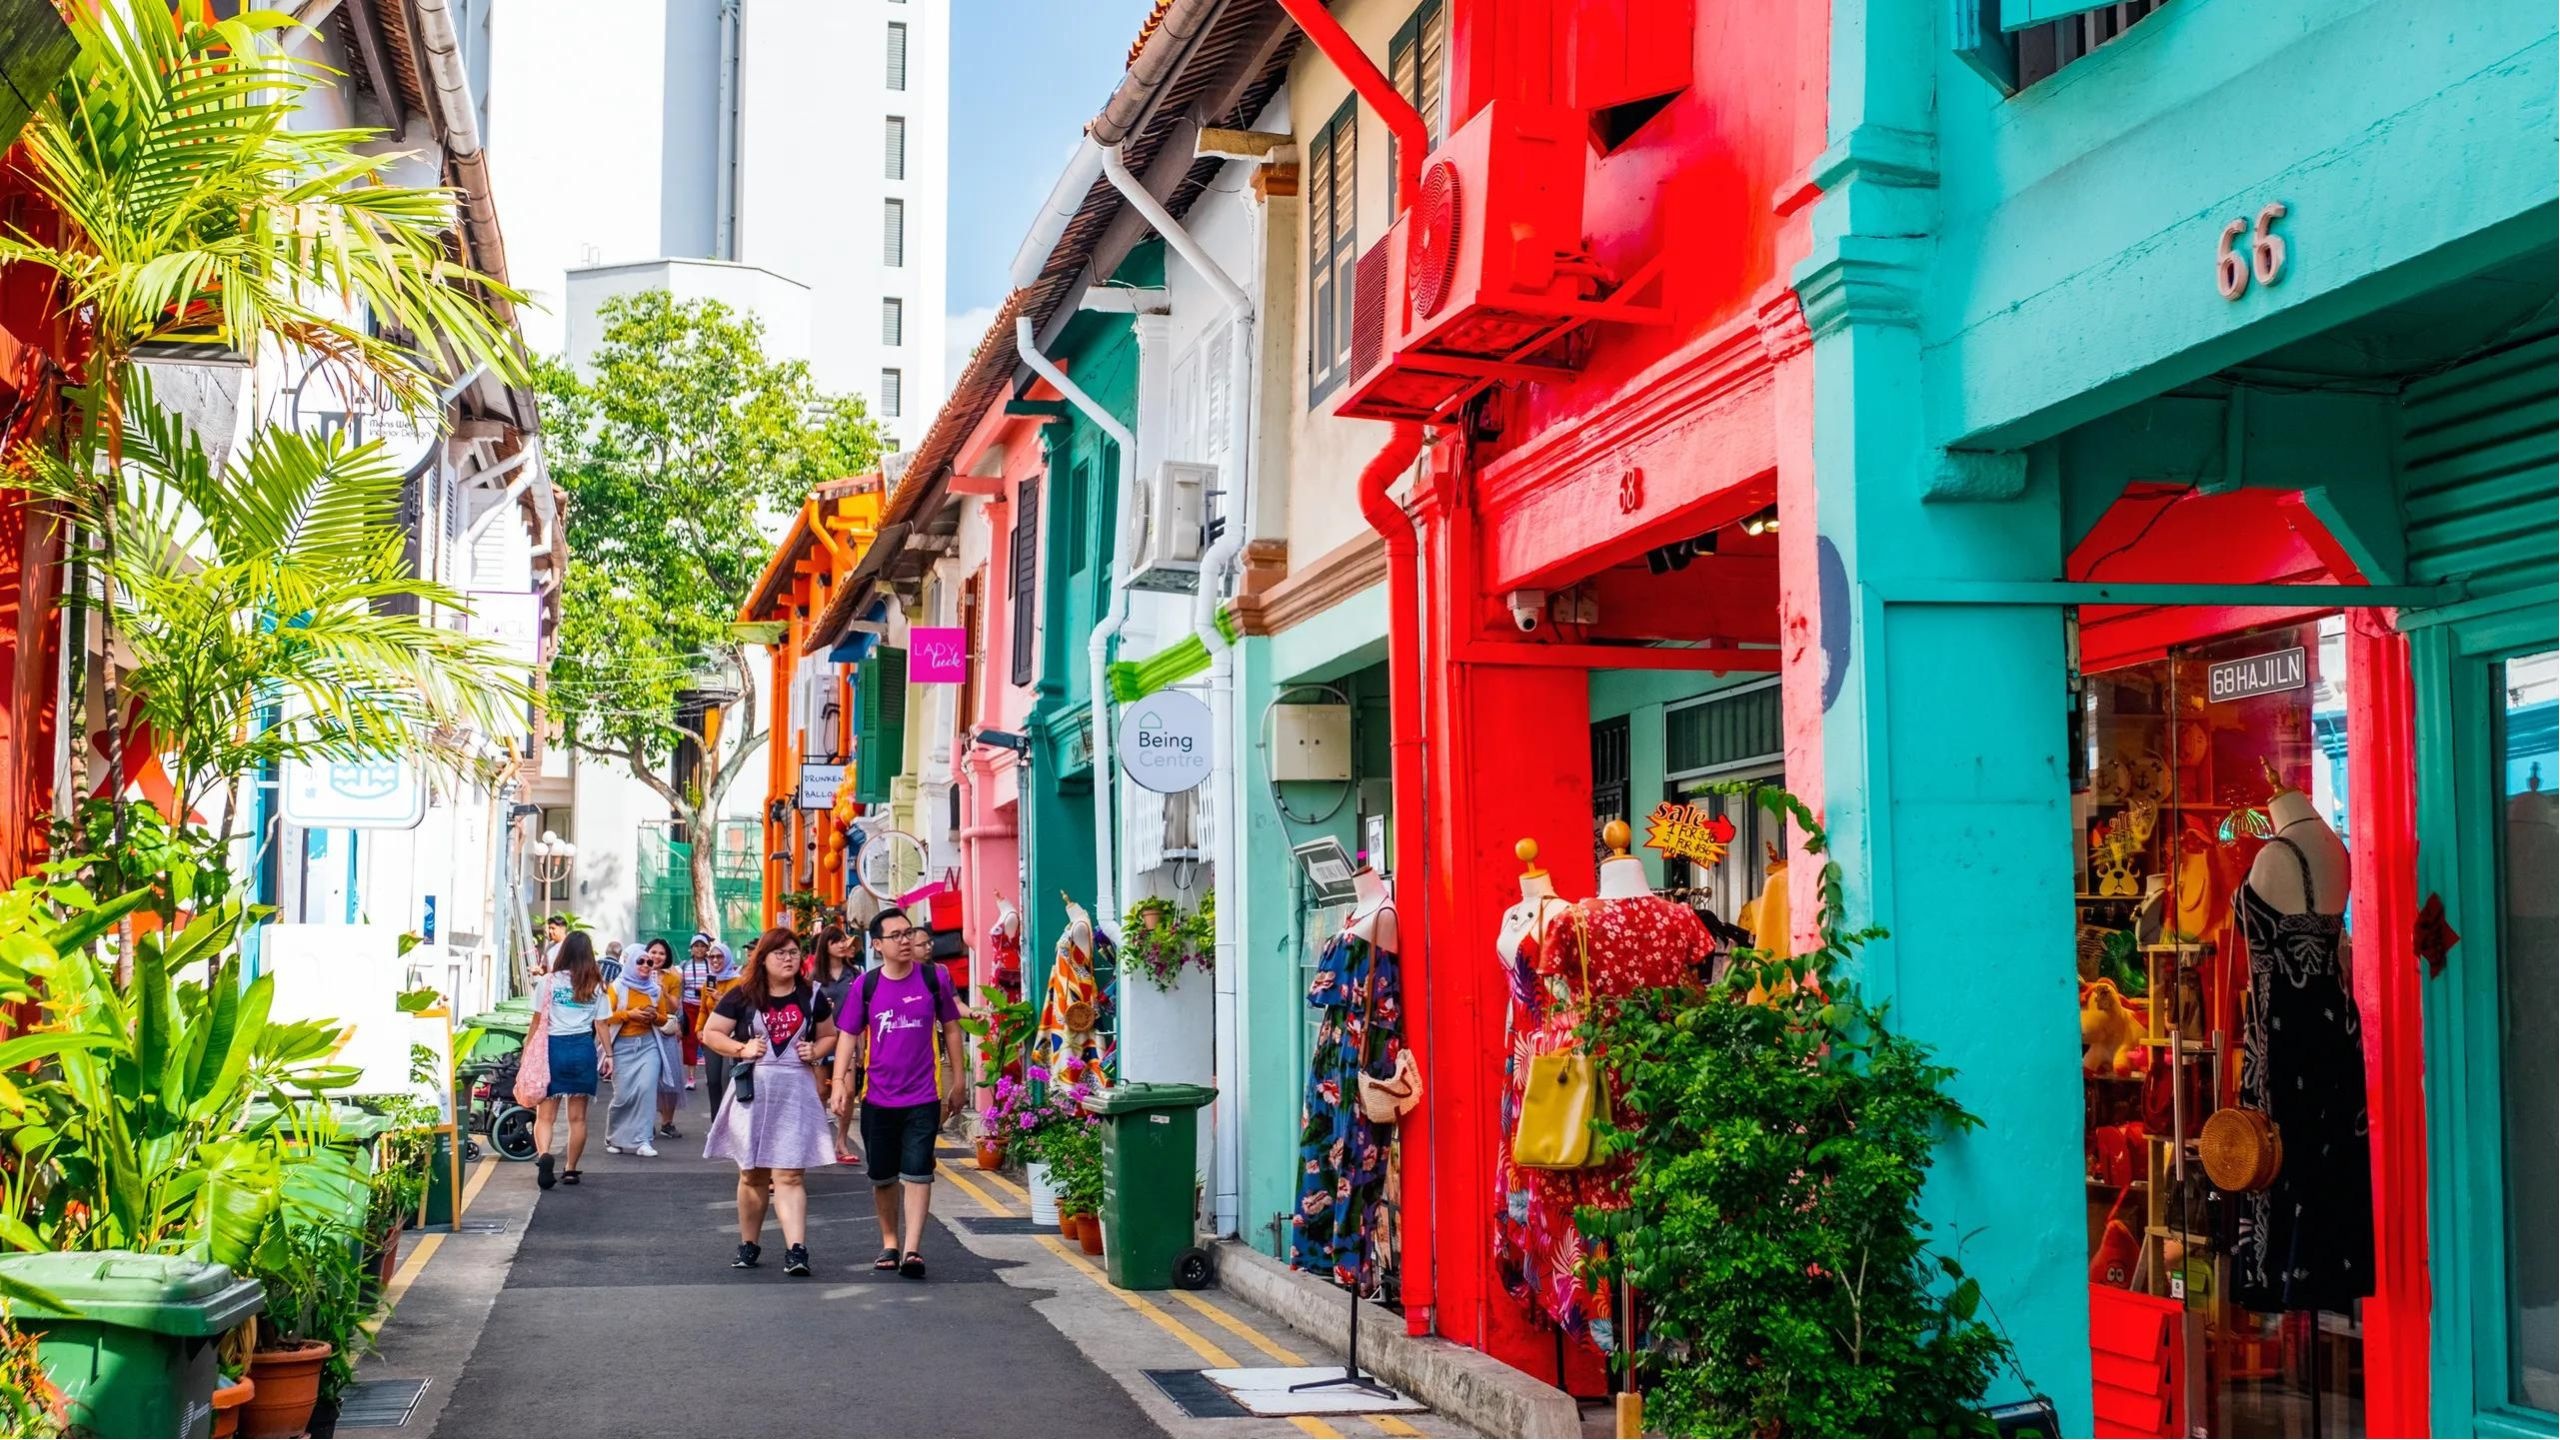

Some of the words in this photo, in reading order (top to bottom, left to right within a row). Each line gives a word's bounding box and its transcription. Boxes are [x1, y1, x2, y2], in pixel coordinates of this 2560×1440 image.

[2217, 203, 2287, 301] 66
[914, 642, 957, 656] LADY
[2213, 654, 2300, 695] 68HAJILN
[1139, 731, 1193, 753] Being
[1139, 750, 1204, 767] Centre
[1667, 822, 1675, 835] 1
[1679, 825, 1697, 839] FOR
[1676, 837, 1692, 851] FOR
